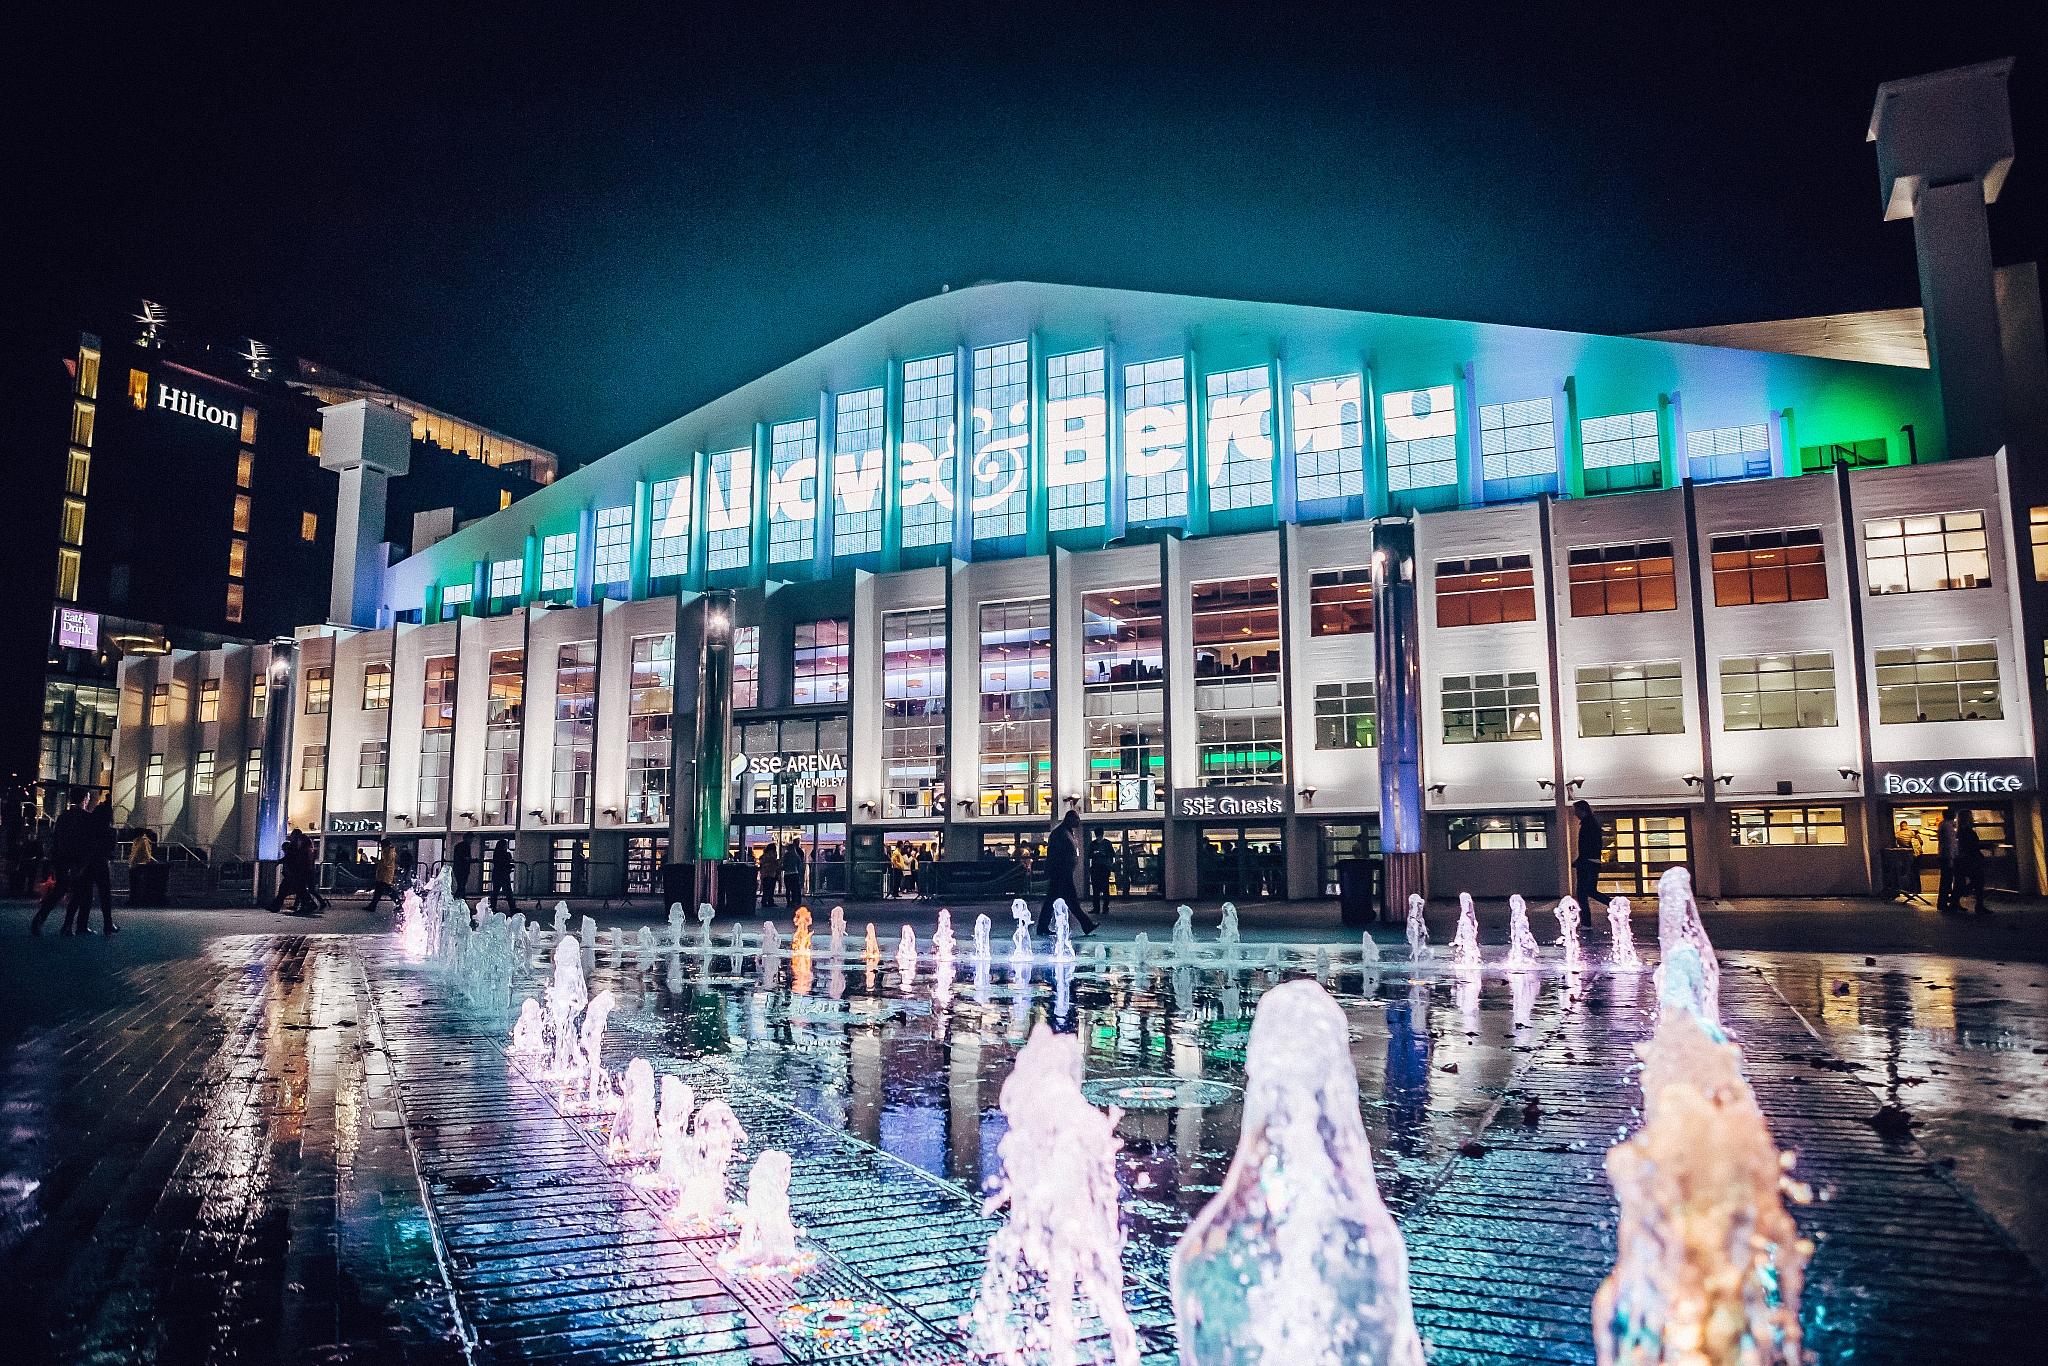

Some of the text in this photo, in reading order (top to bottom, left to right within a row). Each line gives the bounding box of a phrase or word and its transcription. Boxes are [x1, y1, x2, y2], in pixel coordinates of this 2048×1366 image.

[157, 383, 238, 430] Hilton
[931, 400, 1029, 511] &
[786, 753, 843, 773] ARENA
[796, 777, 844, 789] WEMBLEY
[1884, 771, 2023, 794] Box Office
[1182, 795, 1284, 816] SSE Guests
